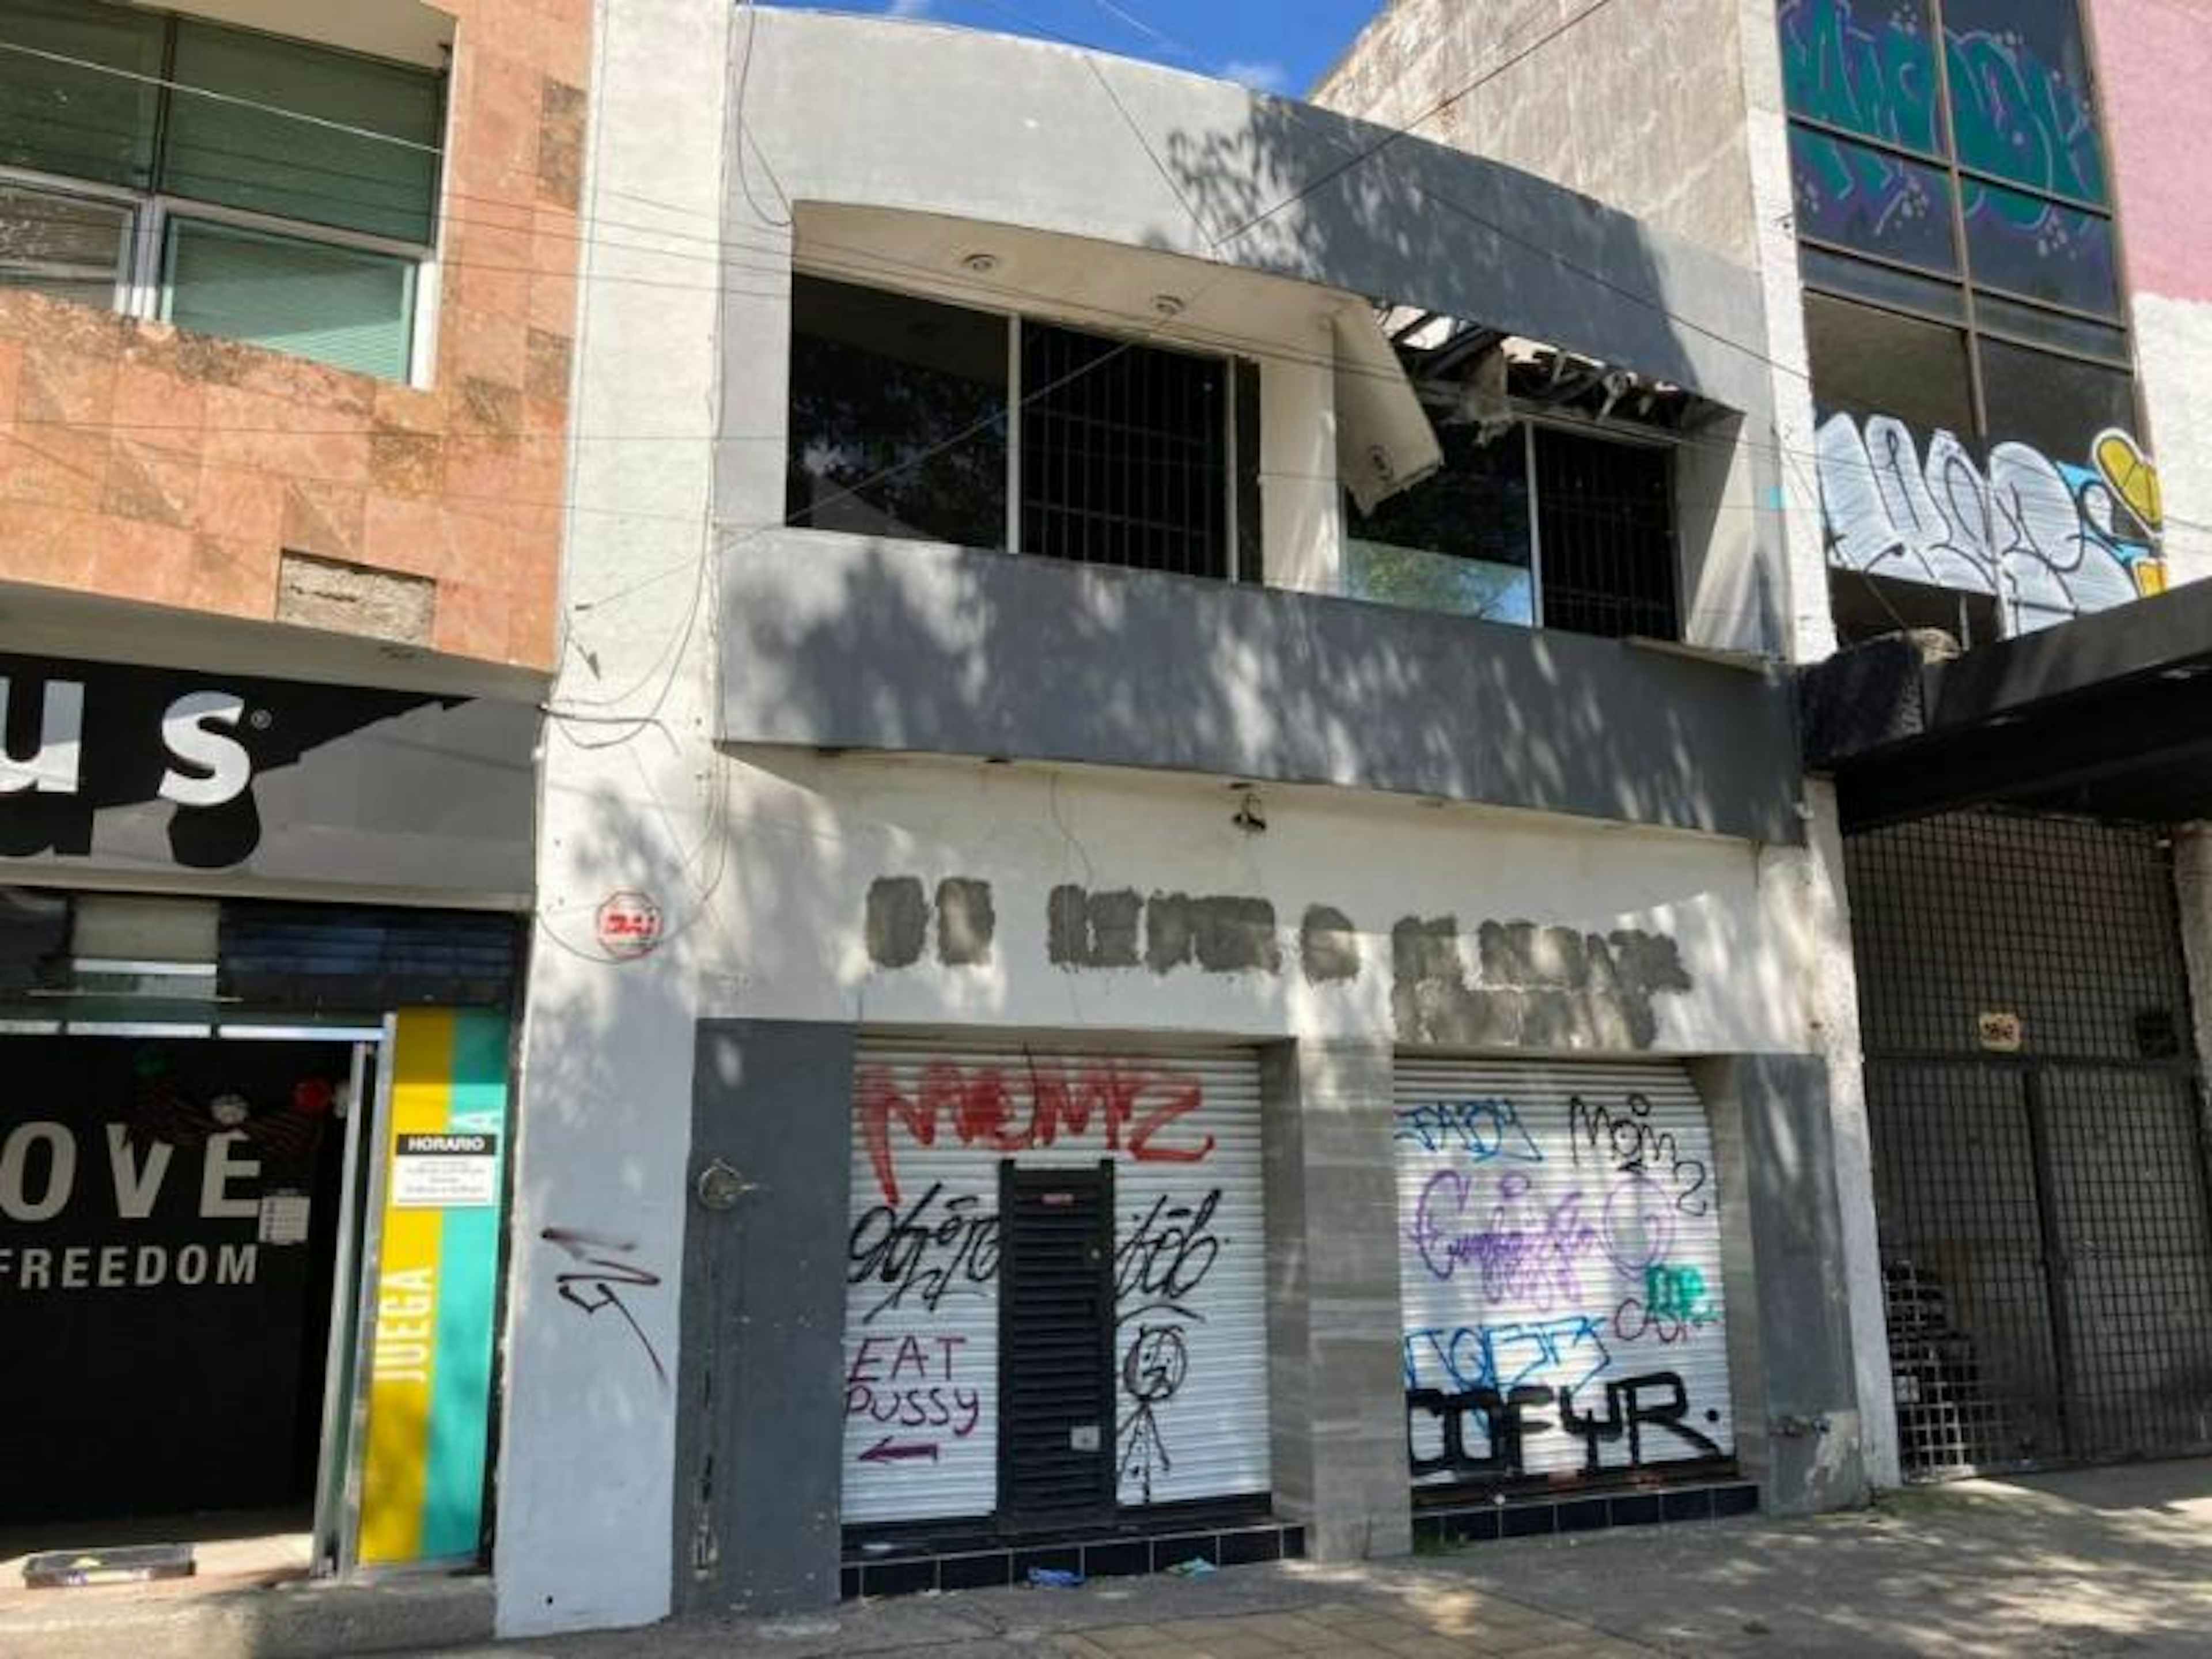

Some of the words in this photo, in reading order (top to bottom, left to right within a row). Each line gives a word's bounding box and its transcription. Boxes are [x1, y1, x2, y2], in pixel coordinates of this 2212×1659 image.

[408, 1136, 485, 1151] HORARIO
[374, 1266, 433, 1382] JUEGA
[848, 1335, 965, 1383] EAT
